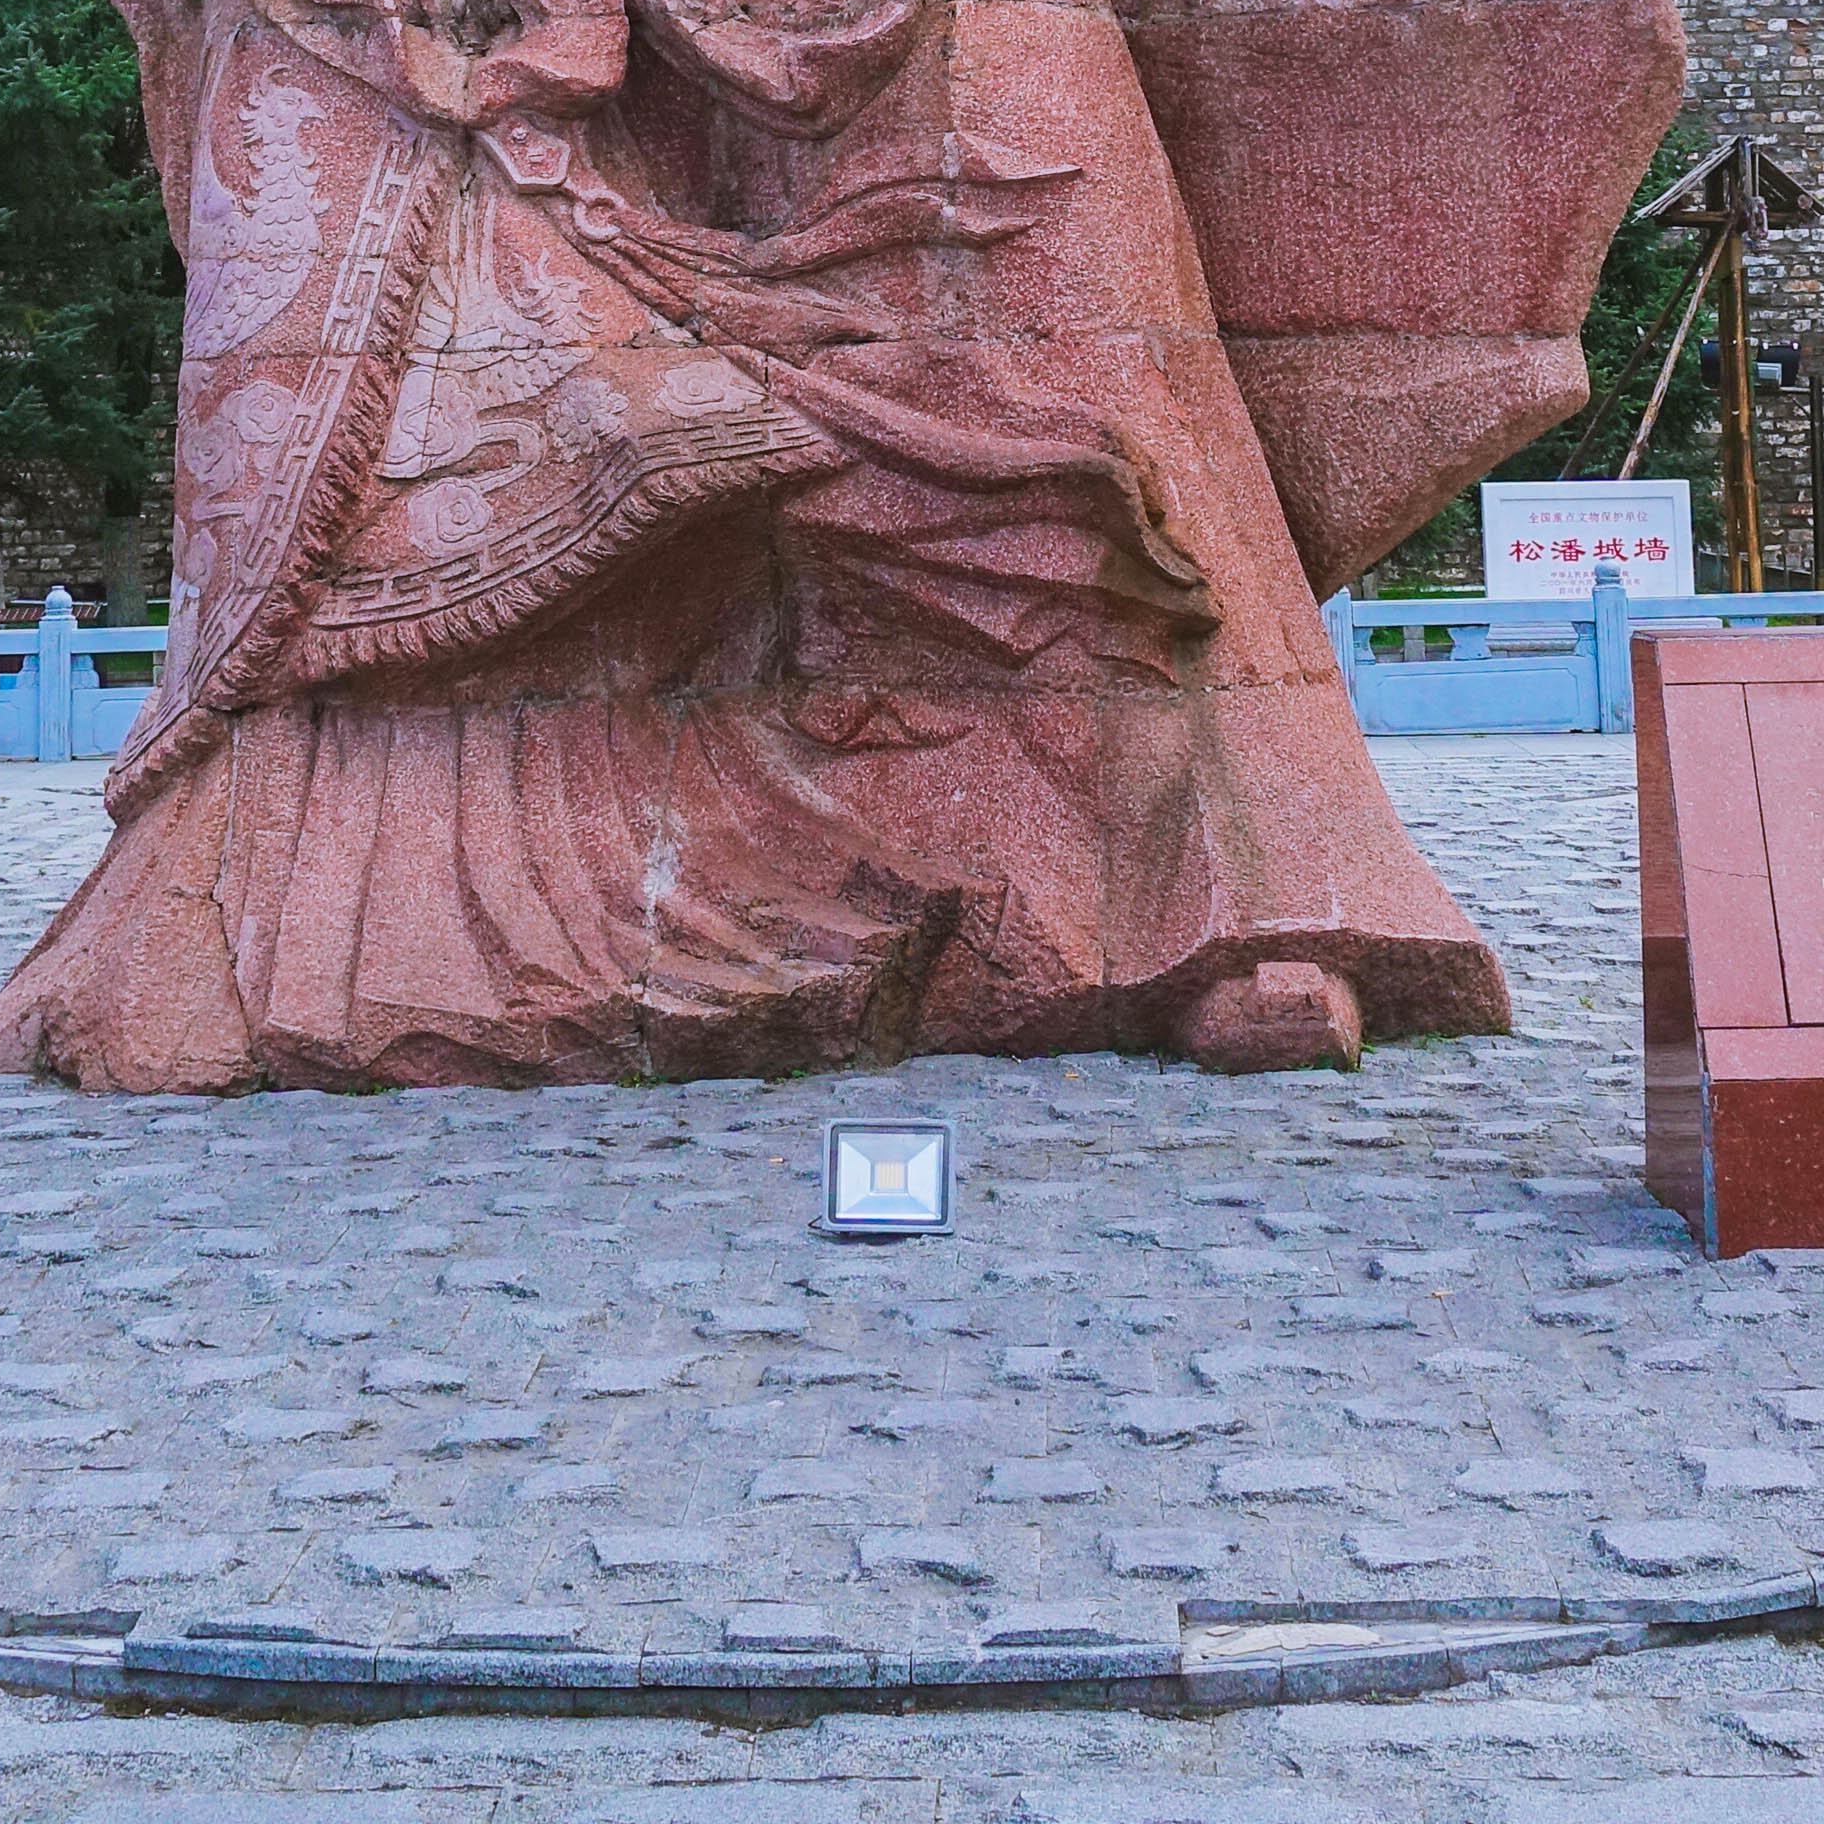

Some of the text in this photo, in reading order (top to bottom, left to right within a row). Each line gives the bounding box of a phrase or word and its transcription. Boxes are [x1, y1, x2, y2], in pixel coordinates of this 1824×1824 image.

[1528, 510, 1649, 524] 全国重点文物保护单位
[1509, 537, 1670, 563] 松潘城墙
